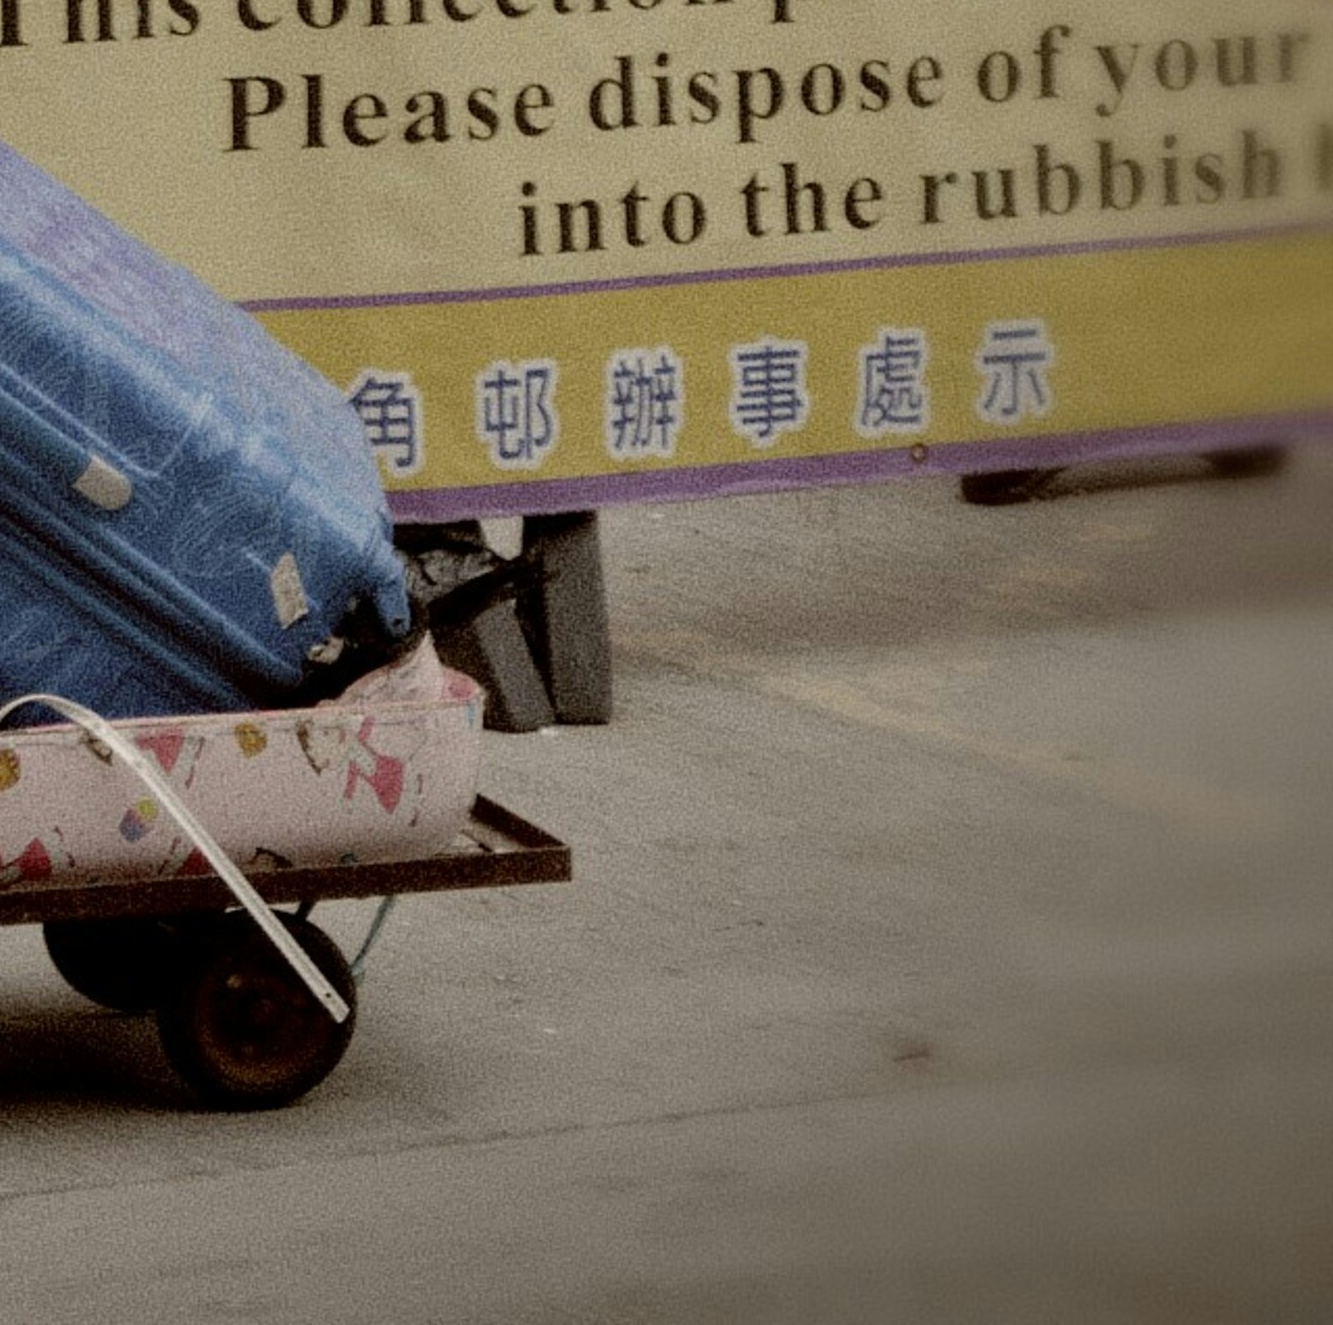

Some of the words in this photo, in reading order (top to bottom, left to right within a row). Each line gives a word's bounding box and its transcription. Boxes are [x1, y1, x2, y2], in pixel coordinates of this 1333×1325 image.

[223, 70, 555, 153] Please
[588, 51, 944, 143] dispose
[976, 25, 1071, 101] of
[1094, 29, 1310, 116] your
[517, 182, 709, 256] into
[739, 162, 885, 238] the
[917, 130, 1283, 226] rubbish
